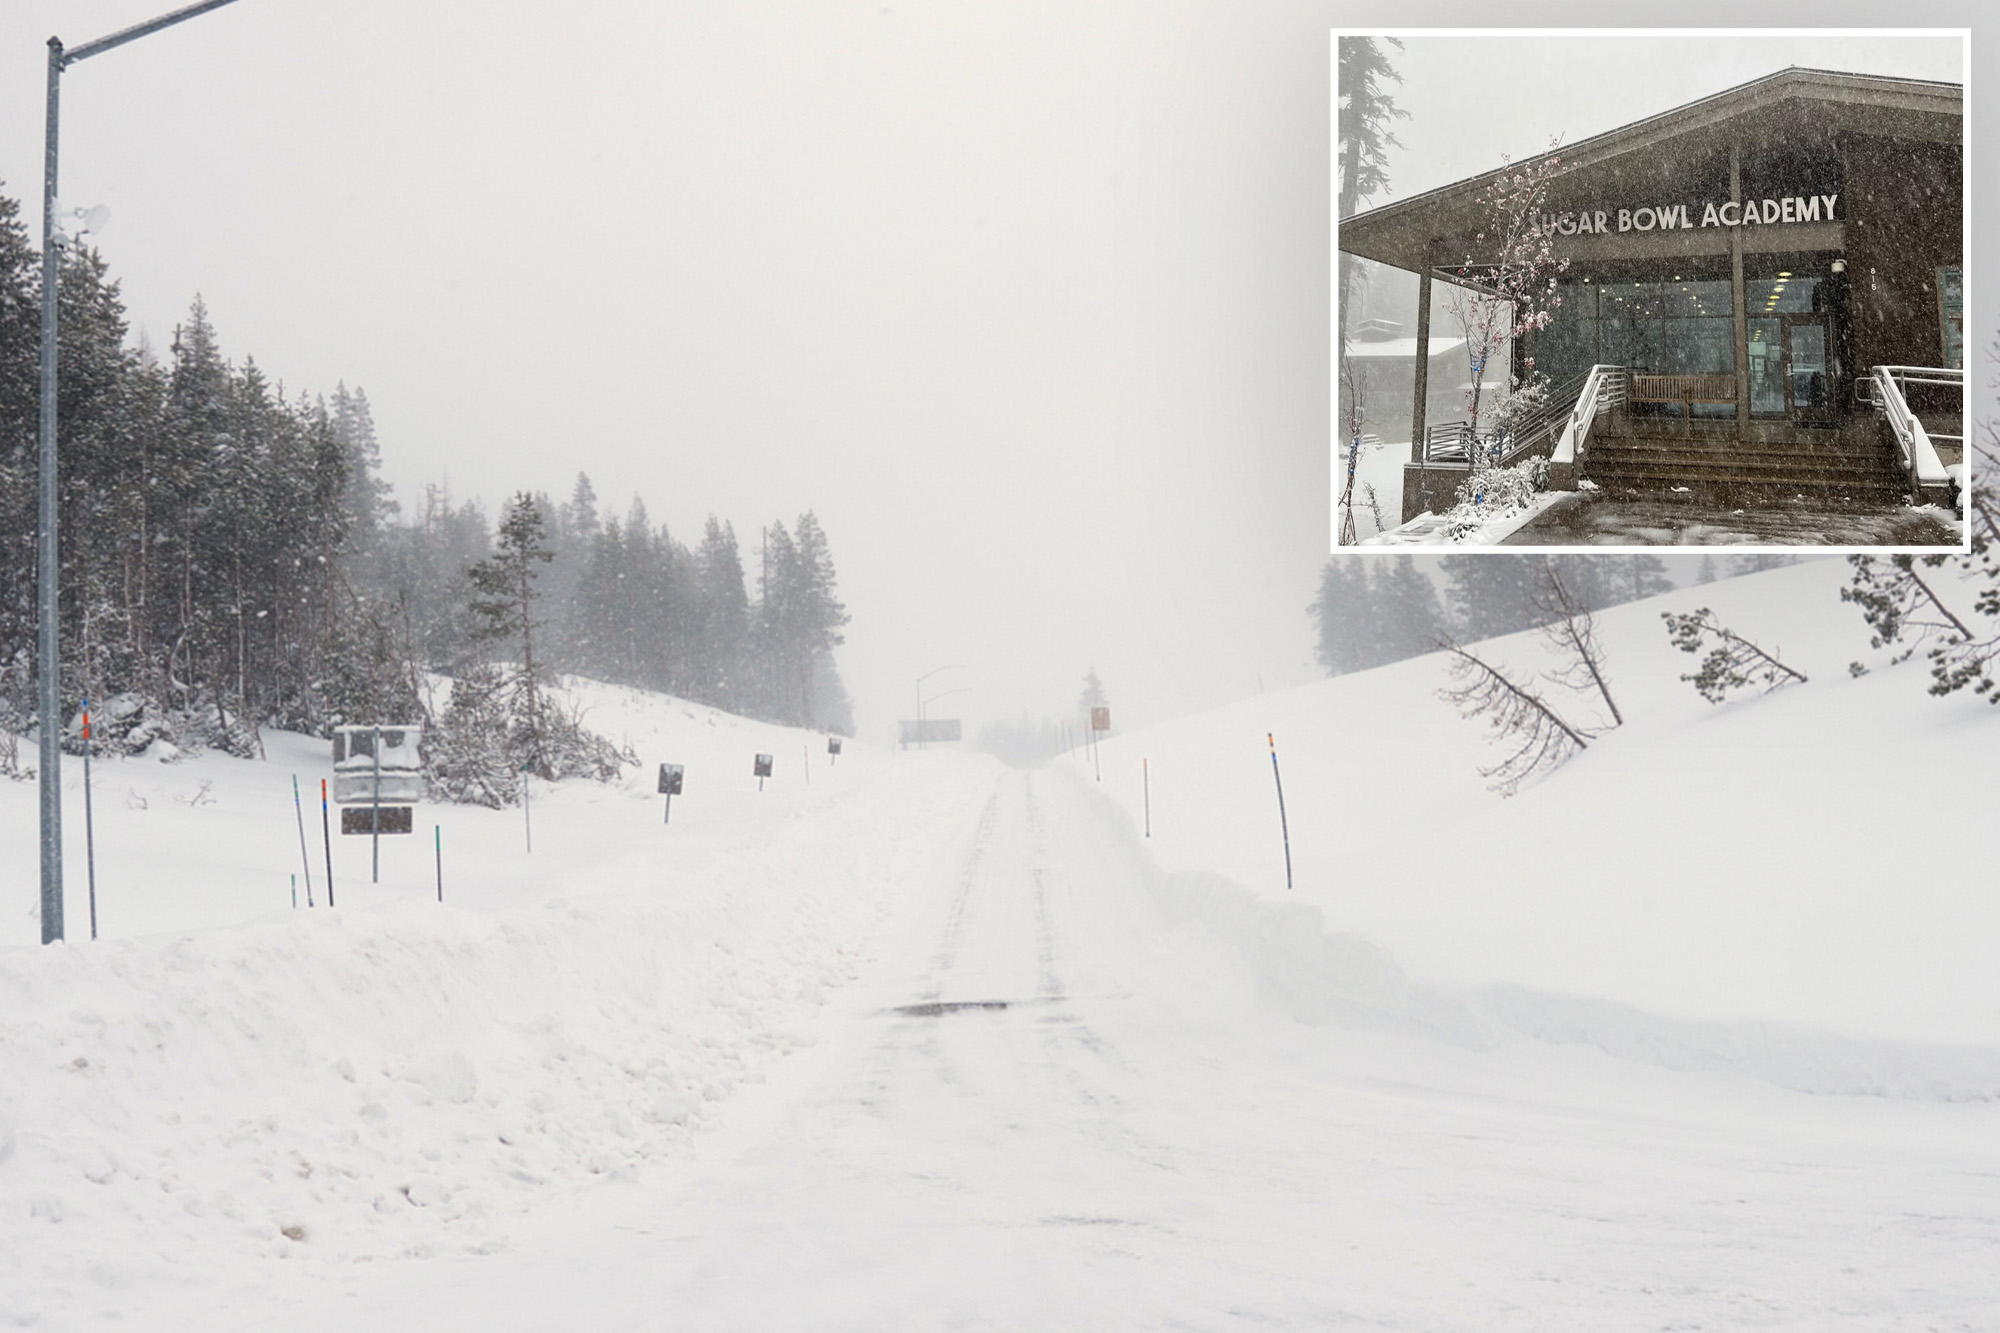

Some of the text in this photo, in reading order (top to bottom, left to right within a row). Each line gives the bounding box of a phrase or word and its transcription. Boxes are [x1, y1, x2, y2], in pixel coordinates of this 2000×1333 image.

[1528, 194, 1839, 236] SUGAR BOWL ACADEMY
